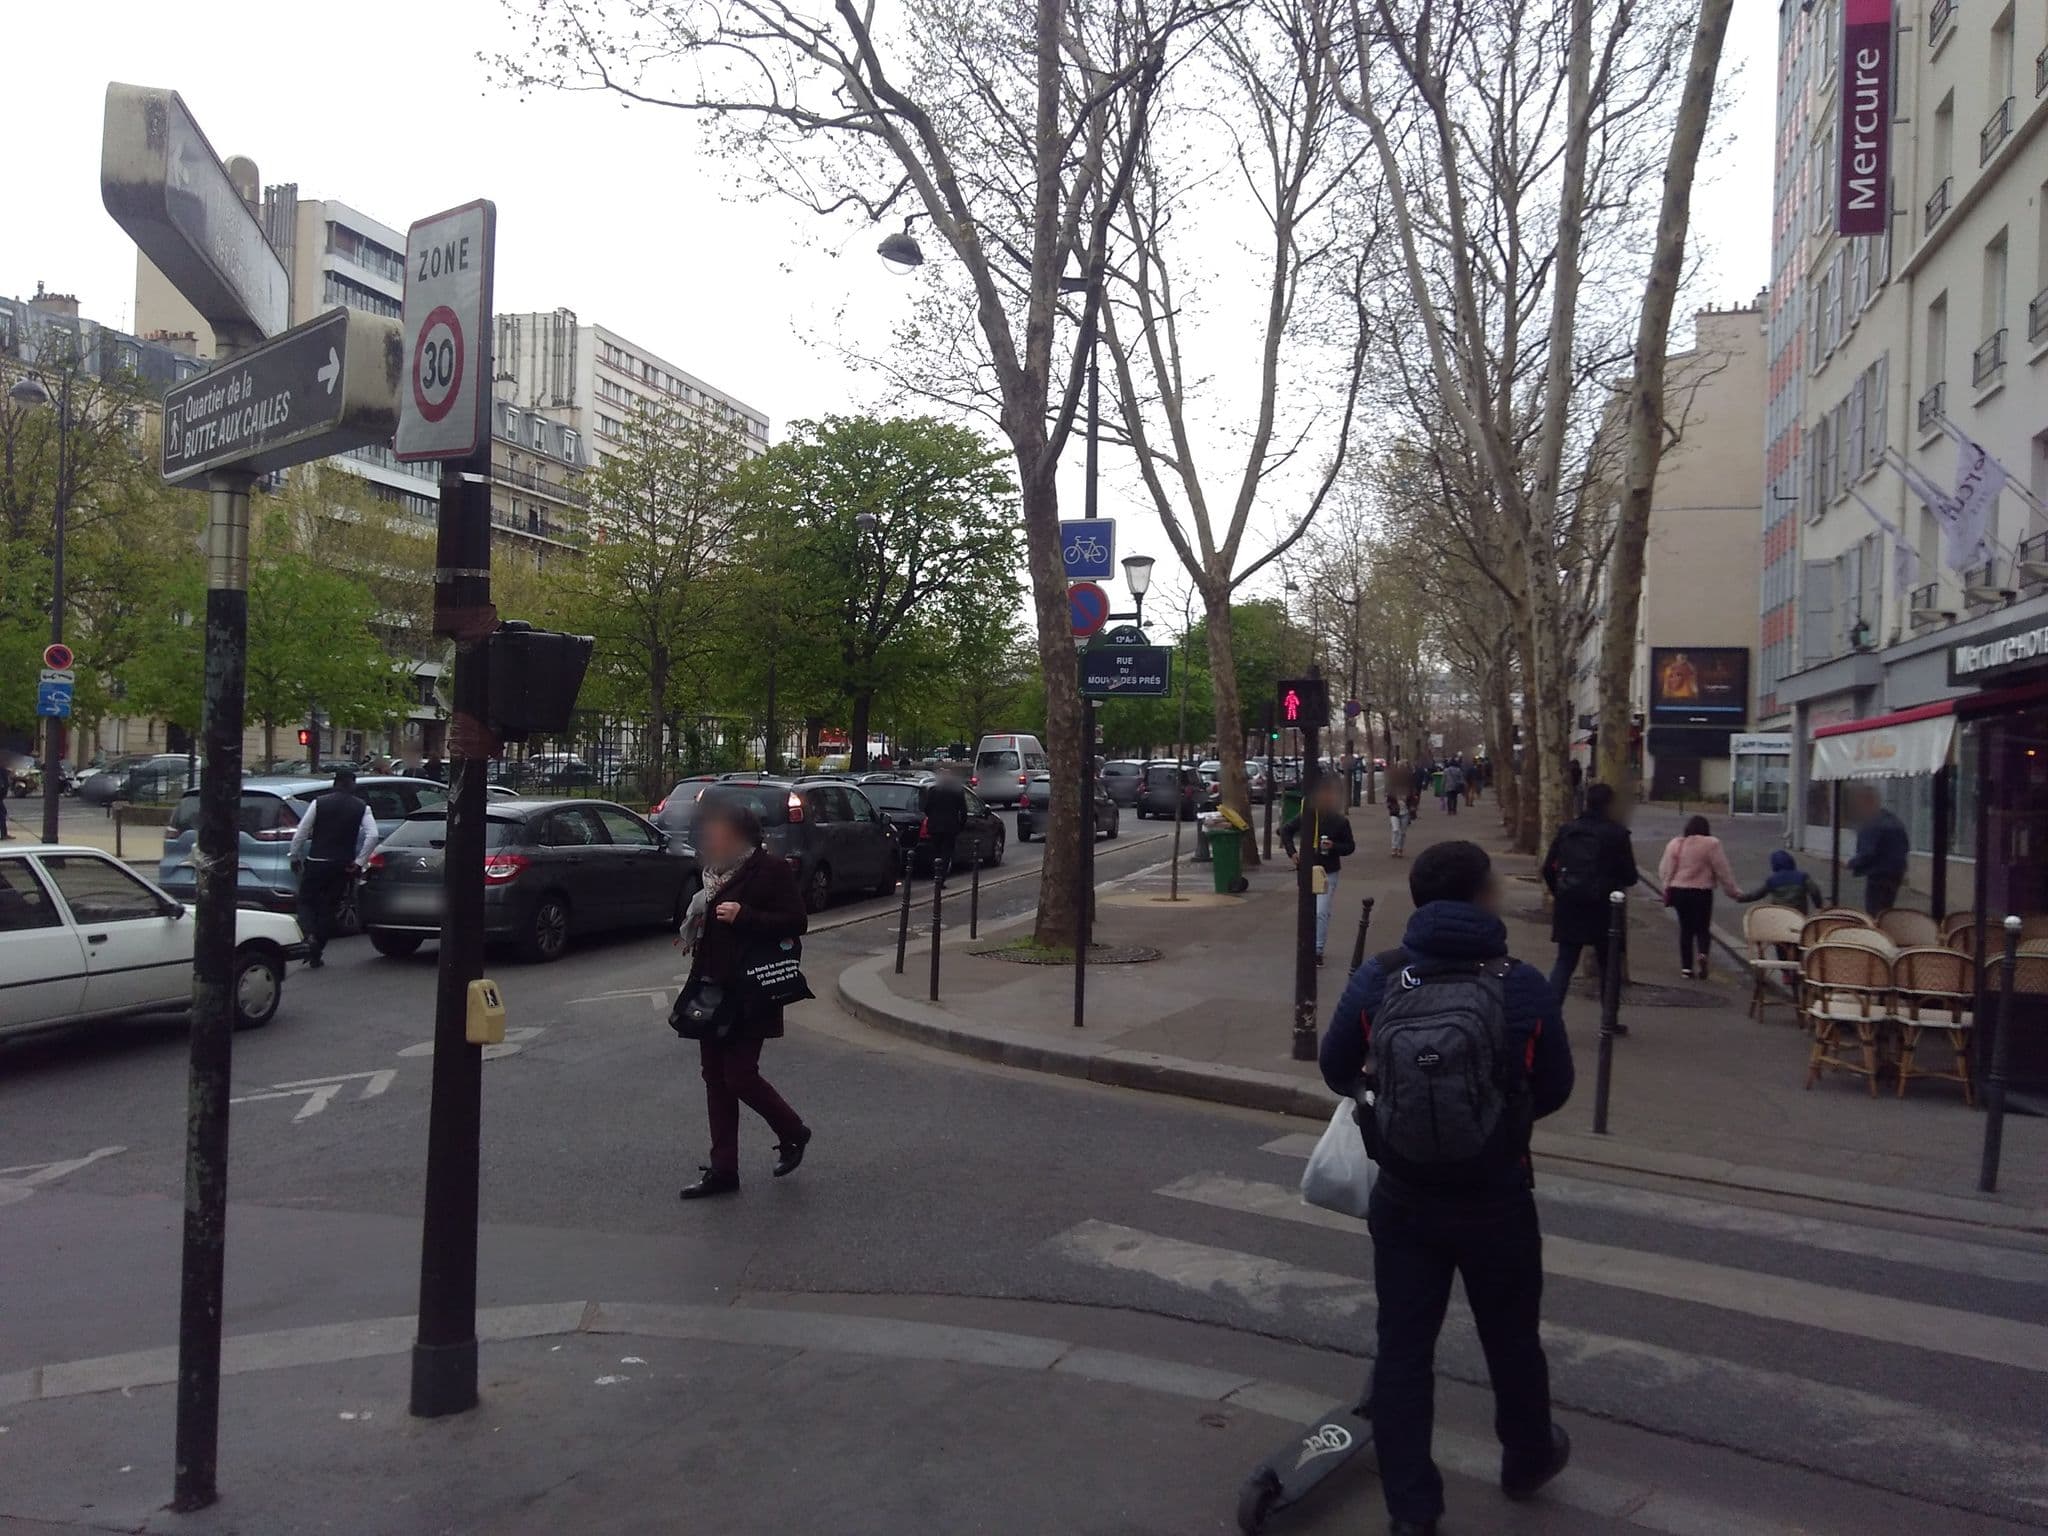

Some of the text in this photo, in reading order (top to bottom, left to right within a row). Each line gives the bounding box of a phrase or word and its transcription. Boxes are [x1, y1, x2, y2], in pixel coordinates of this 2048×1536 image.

[1847, 48, 1881, 211] Mercure
[418, 237, 470, 282] ZONE
[422, 338, 454, 390] 30
[185, 370, 253, 423] Quartier de la
[184, 390, 292, 459] BUTTE AUX CAILLES
[1116, 657, 1134, 665] RUE
[1120, 676, 1137, 685] DES
[1138, 674, 1161, 685] PRÉS
[1955, 636, 2018, 675] Mercure
